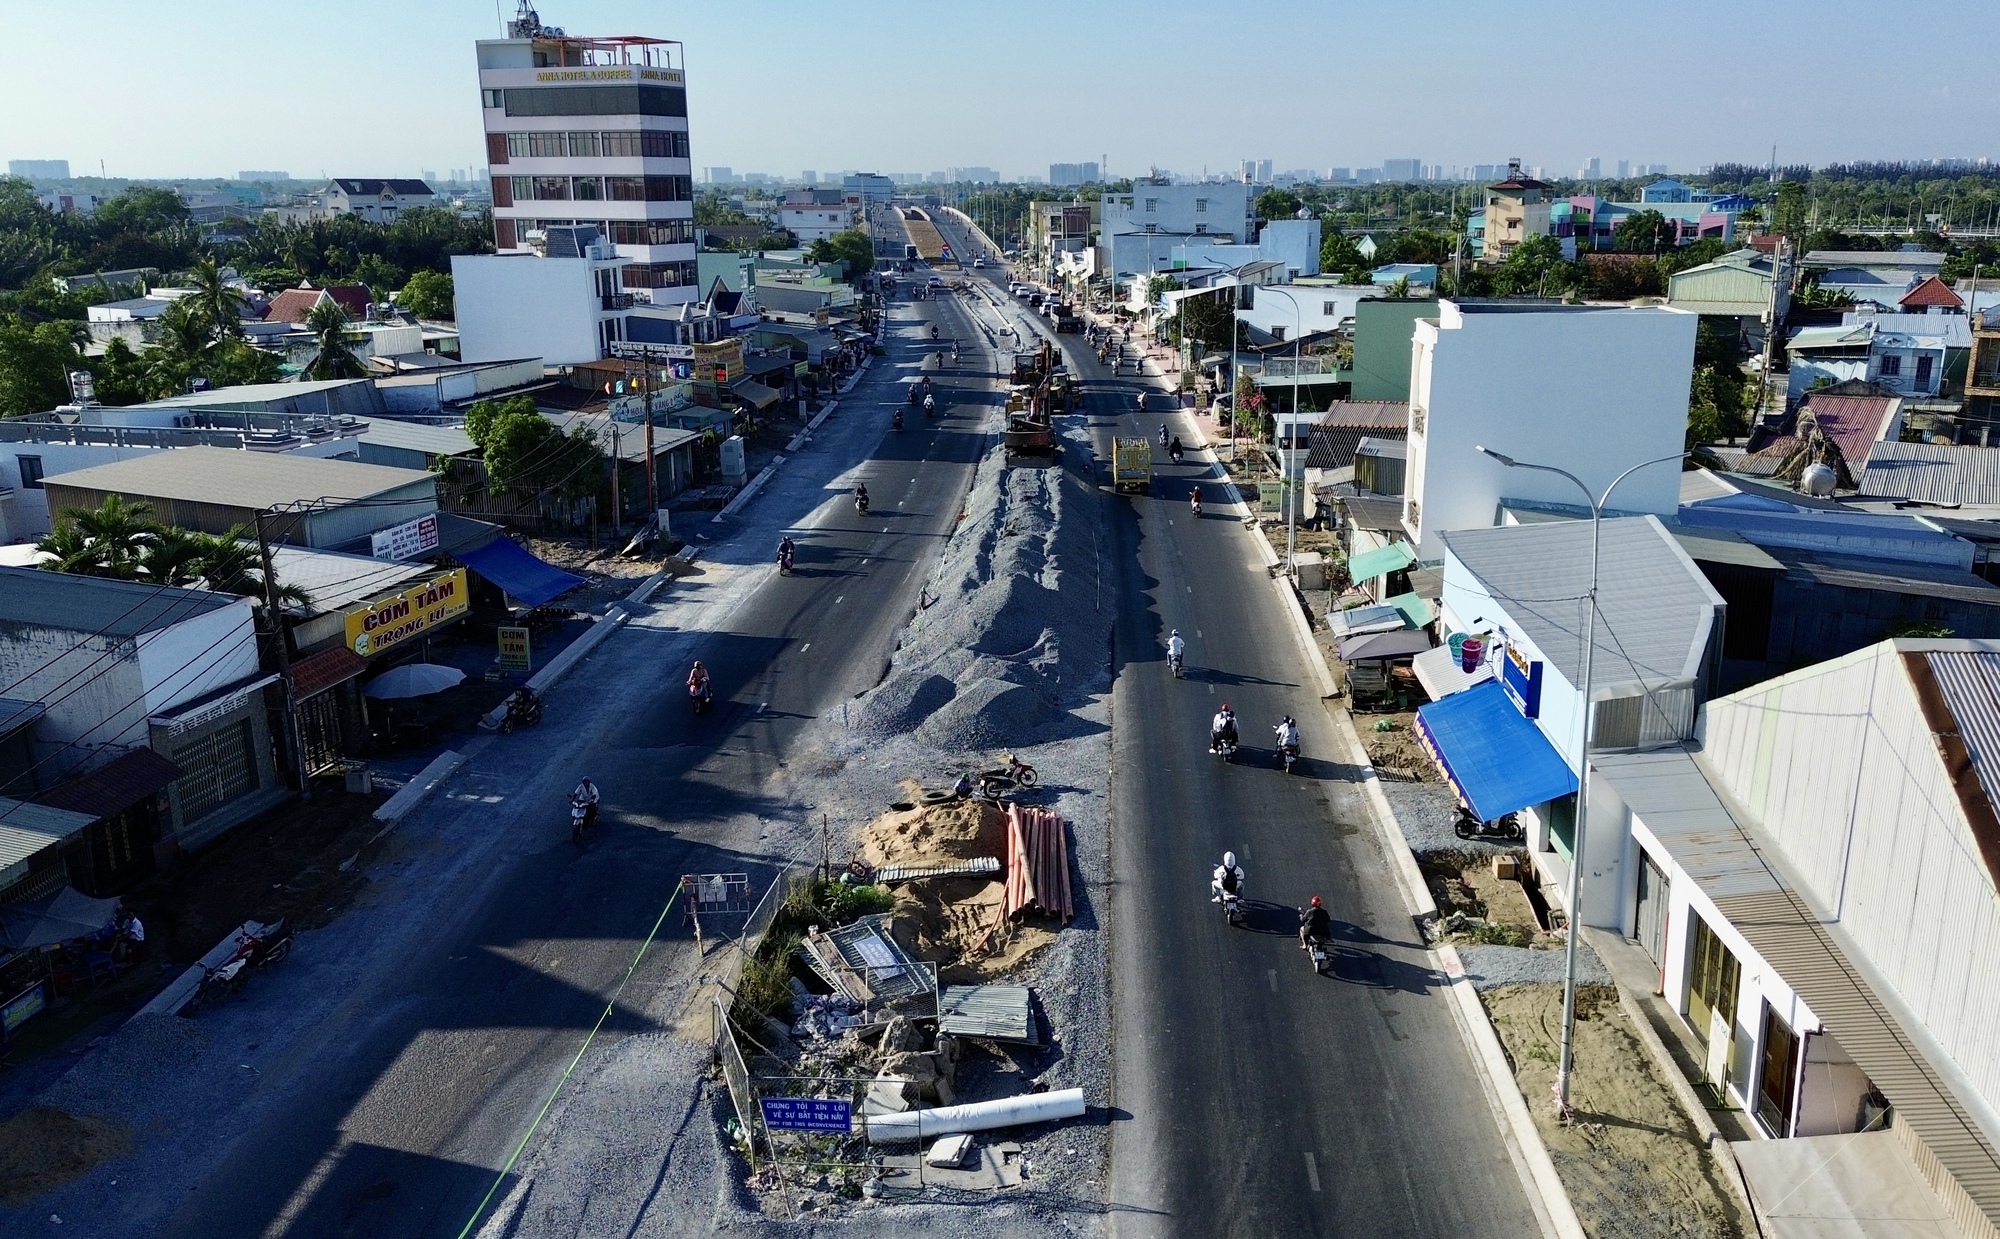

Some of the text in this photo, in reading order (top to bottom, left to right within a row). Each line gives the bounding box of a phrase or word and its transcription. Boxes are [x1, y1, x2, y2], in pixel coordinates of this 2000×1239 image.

[537, 72, 559, 82] ANNA
[560, 71, 587, 81] HOTEL
[641, 69, 682, 82] ANNA HOTEL
[363, 598, 411, 633] CƠM
[373, 615, 425, 649] TRỌNG
[767, 1102, 790, 1110] CHÚNG
[796, 1101, 808, 1110] TÔI
[785, 1112, 796, 1120] SỰ
[814, 1112, 829, 1121] TIỆN
